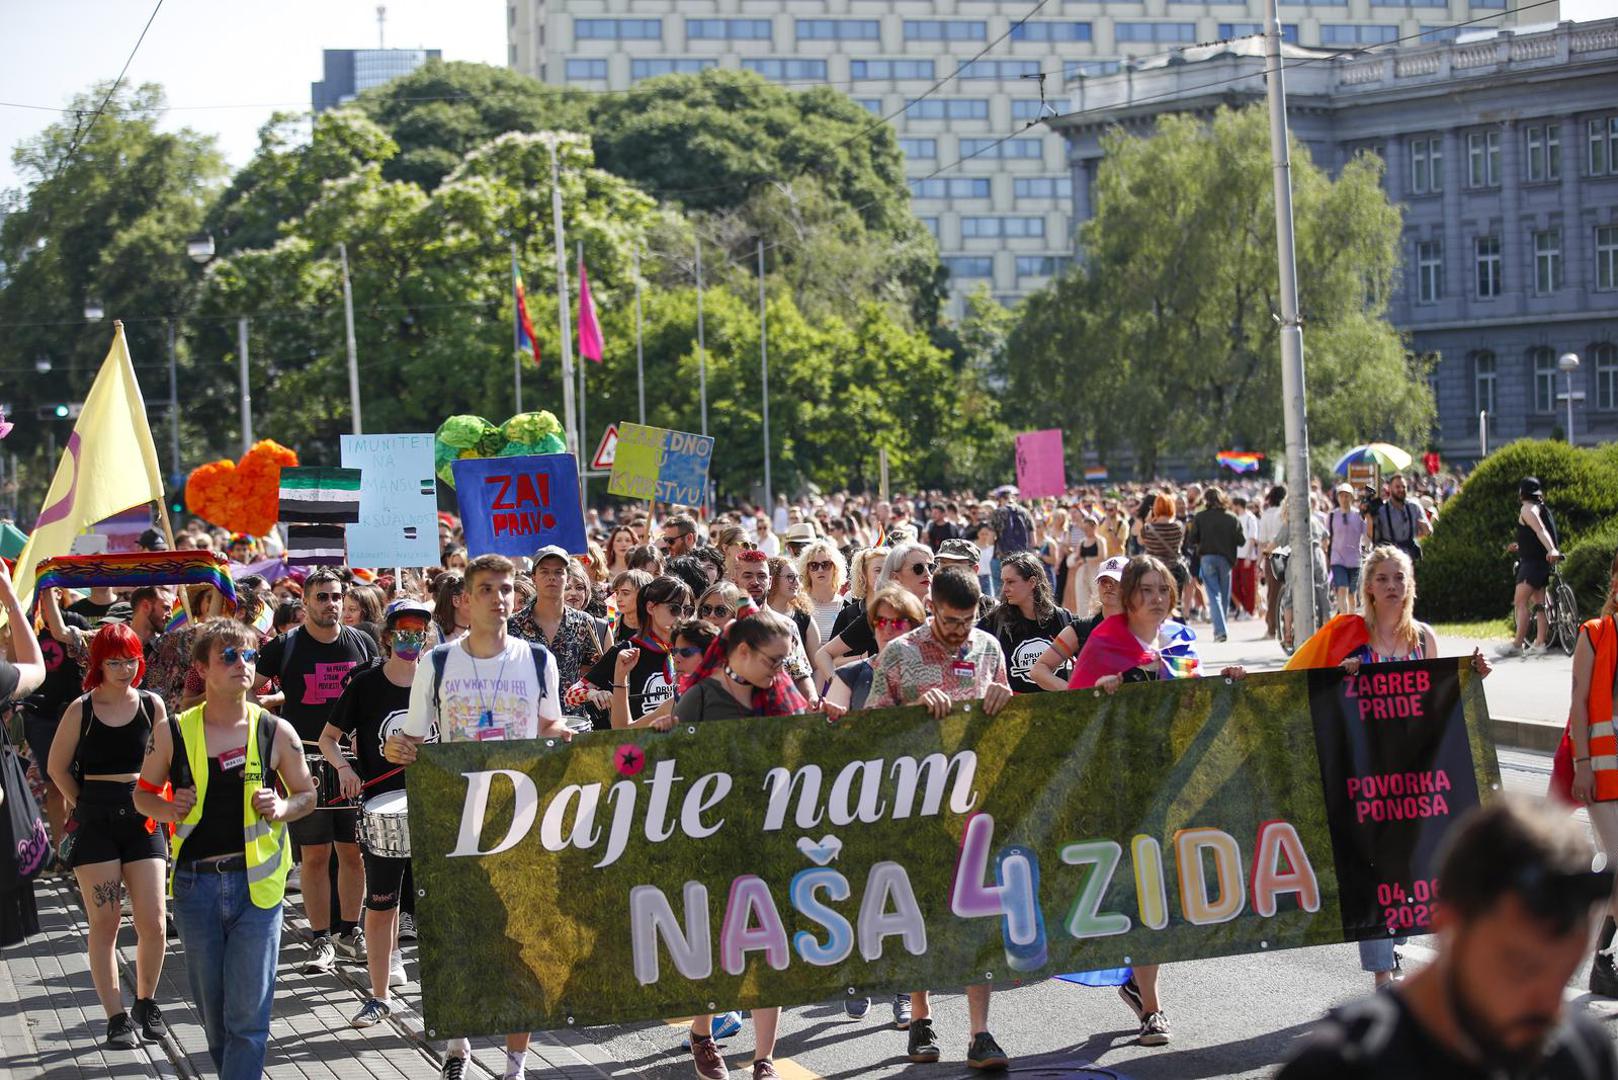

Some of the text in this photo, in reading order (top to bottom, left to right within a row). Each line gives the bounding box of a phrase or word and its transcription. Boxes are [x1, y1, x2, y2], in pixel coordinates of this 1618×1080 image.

[348, 436, 433, 454] IMUNITET
[655, 448, 668, 467] U
[373, 453, 396, 468] NA
[445, 679, 528, 697] SAY WHAT YOU FEEL
[1344, 670, 1431, 698] ZAGREB
[1358, 694, 1424, 720] PRIDE
[1347, 770, 1452, 800] POVORKA
[446, 744, 977, 868] Dajte nam
[1357, 794, 1449, 824] PONOSA
[630, 811, 1321, 986] NAŠA 4 ZIDA
